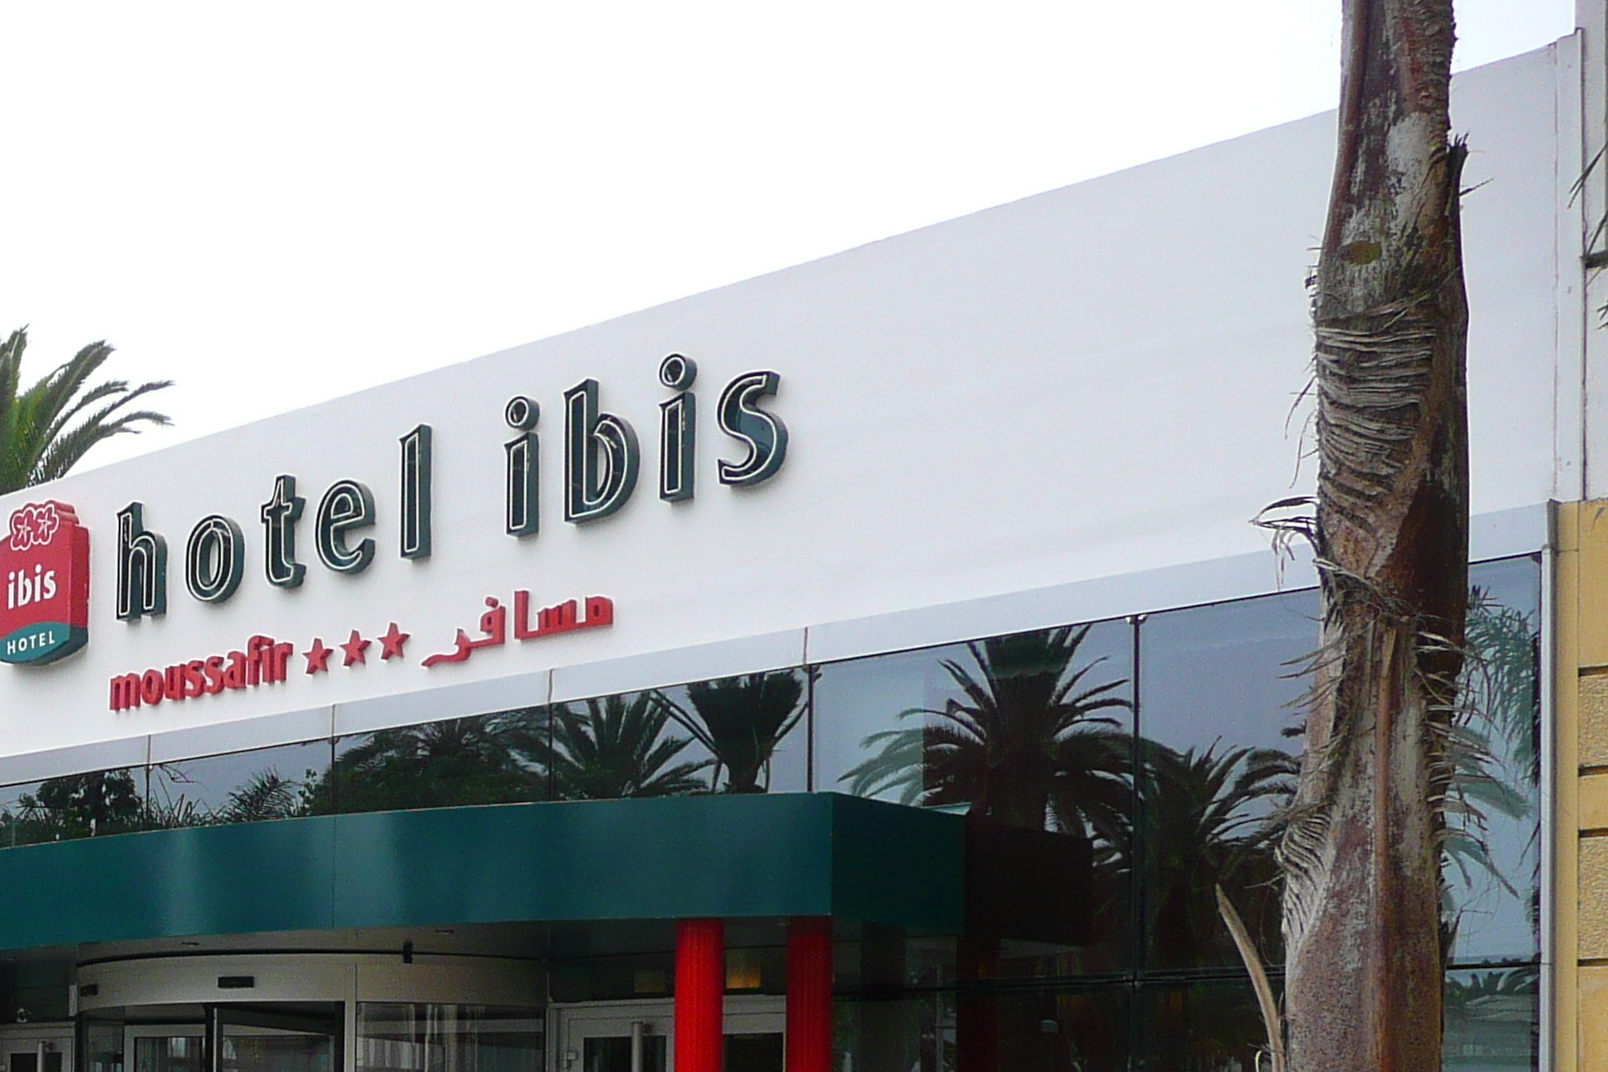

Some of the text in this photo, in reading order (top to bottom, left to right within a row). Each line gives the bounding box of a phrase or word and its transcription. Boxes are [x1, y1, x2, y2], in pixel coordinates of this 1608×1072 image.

[116, 353, 789, 621] hotel ibis
[7, 564, 57, 609] ibis
[7, 630, 55, 655] HOTEL
[421, 589, 614, 667] مسافر
[110, 634, 293, 711] moussafir
